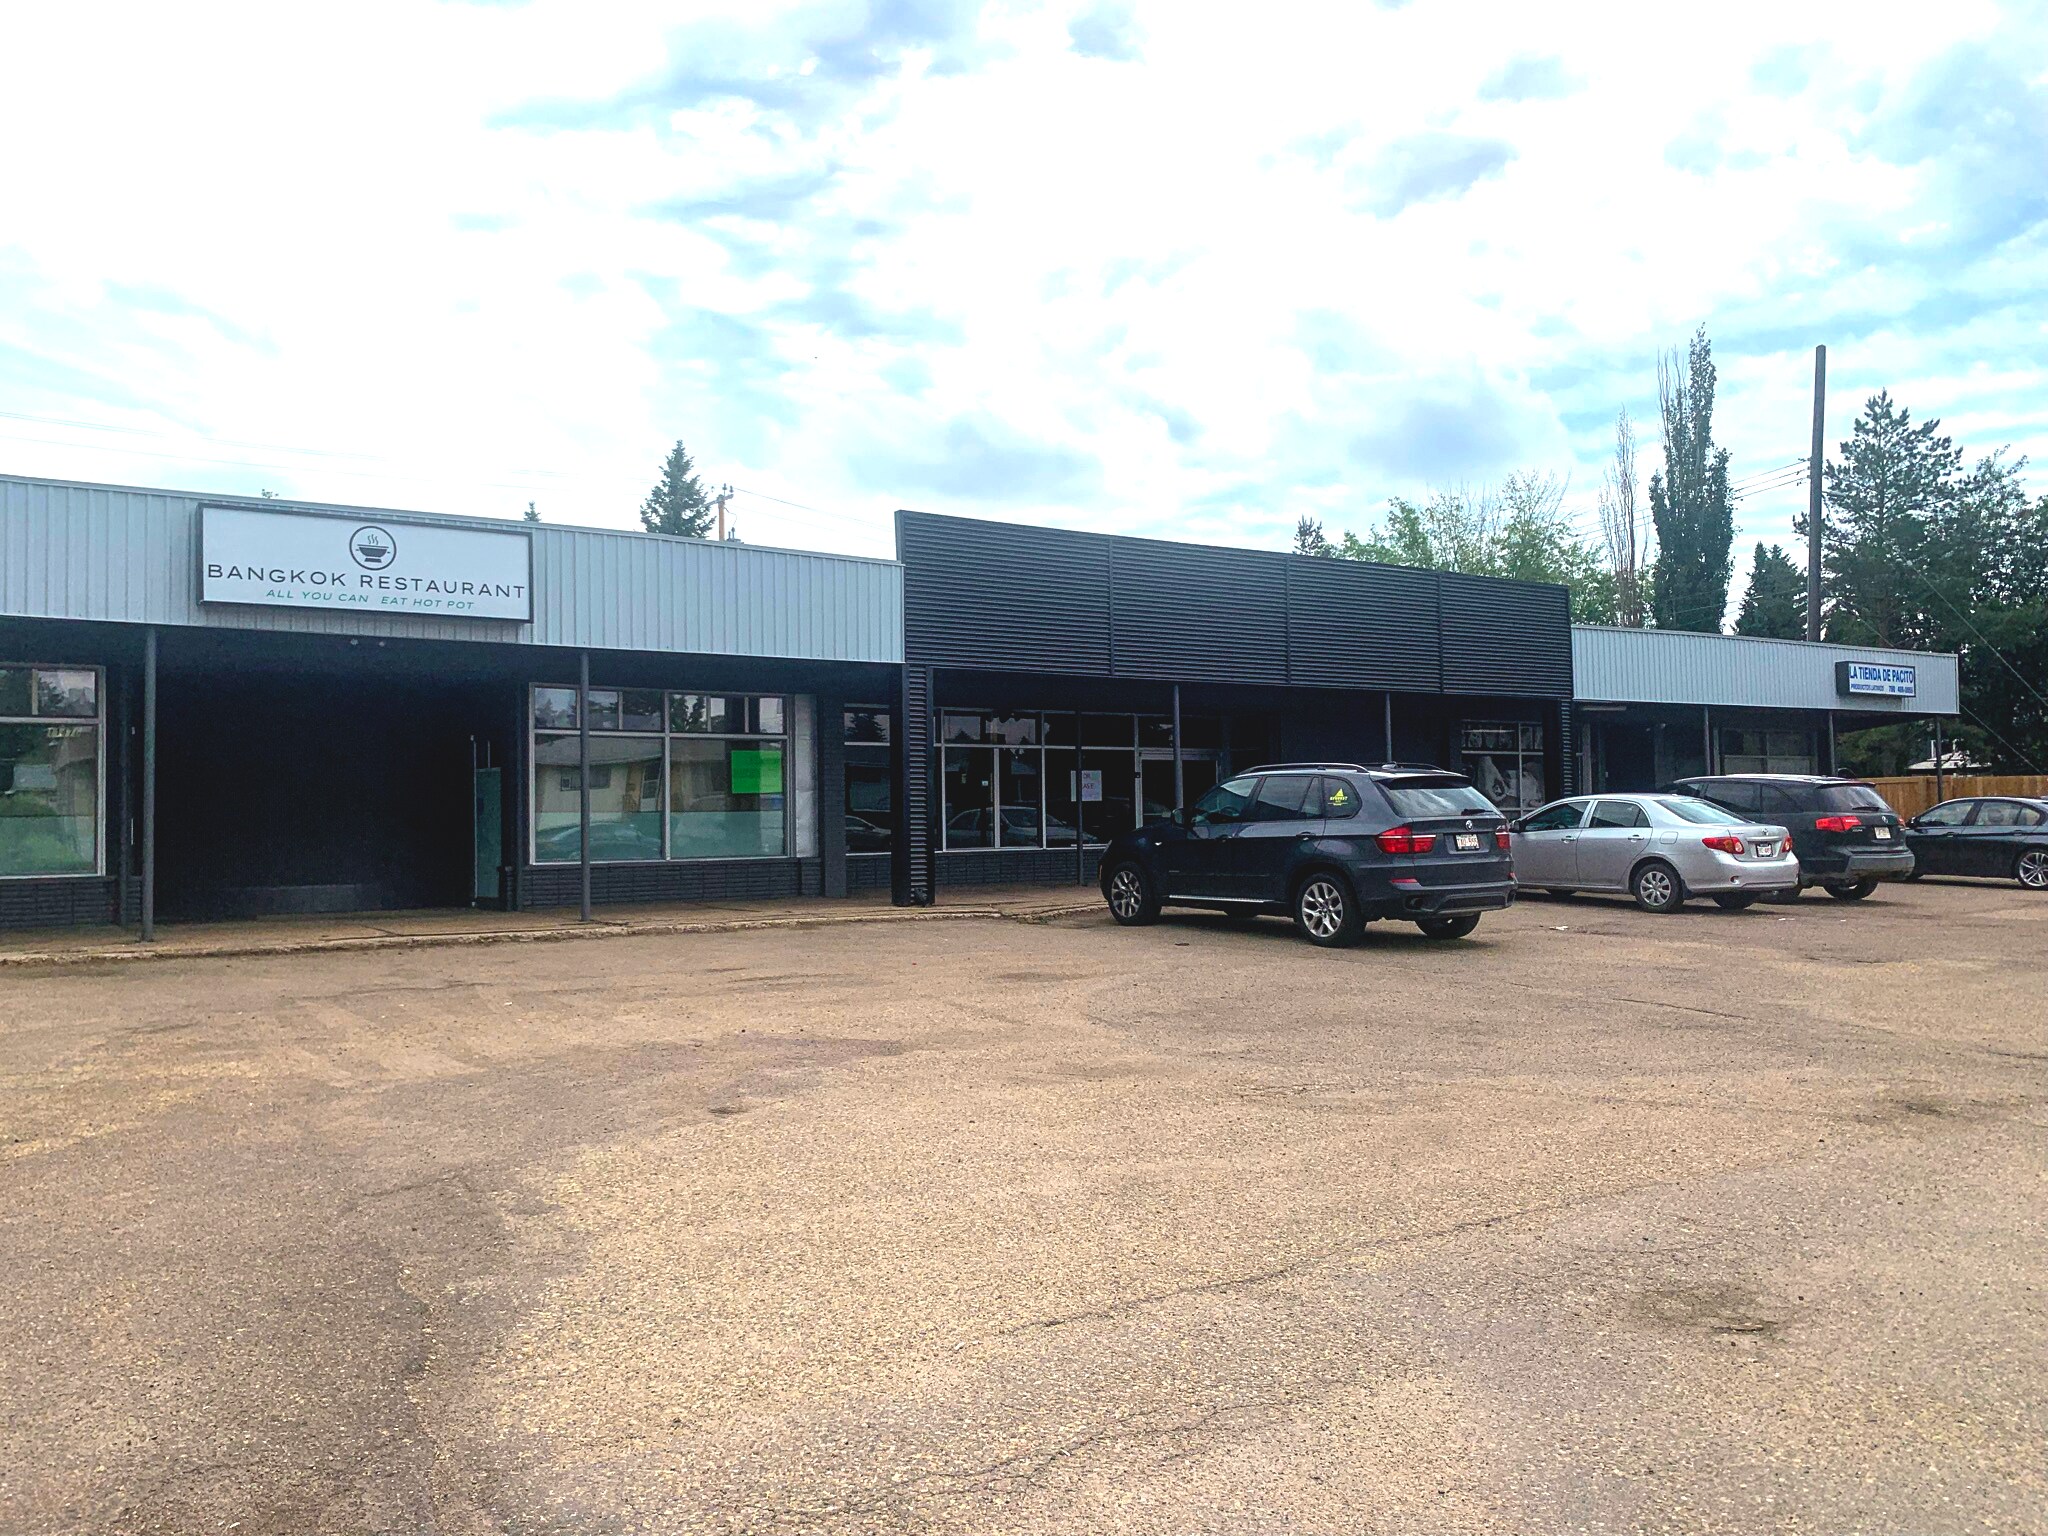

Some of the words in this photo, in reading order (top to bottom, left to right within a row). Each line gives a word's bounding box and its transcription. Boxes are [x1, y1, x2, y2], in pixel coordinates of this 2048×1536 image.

[207, 563, 347, 587] BANGKOK
[360, 574, 525, 599] RESTAURANT
[266, 589, 294, 599] ALL
[302, 591, 333, 601] YOU
[338, 593, 369, 603] CAN
[381, 596, 408, 605] EAT
[413, 598, 442, 608] HOT
[447, 600, 475, 610] POT
[1850, 665, 1858, 679] LA
[1859, 666, 1882, 681] TIENDA
[1883, 668, 1891, 682] DE
[1892, 669, 1914, 684] PACITO
